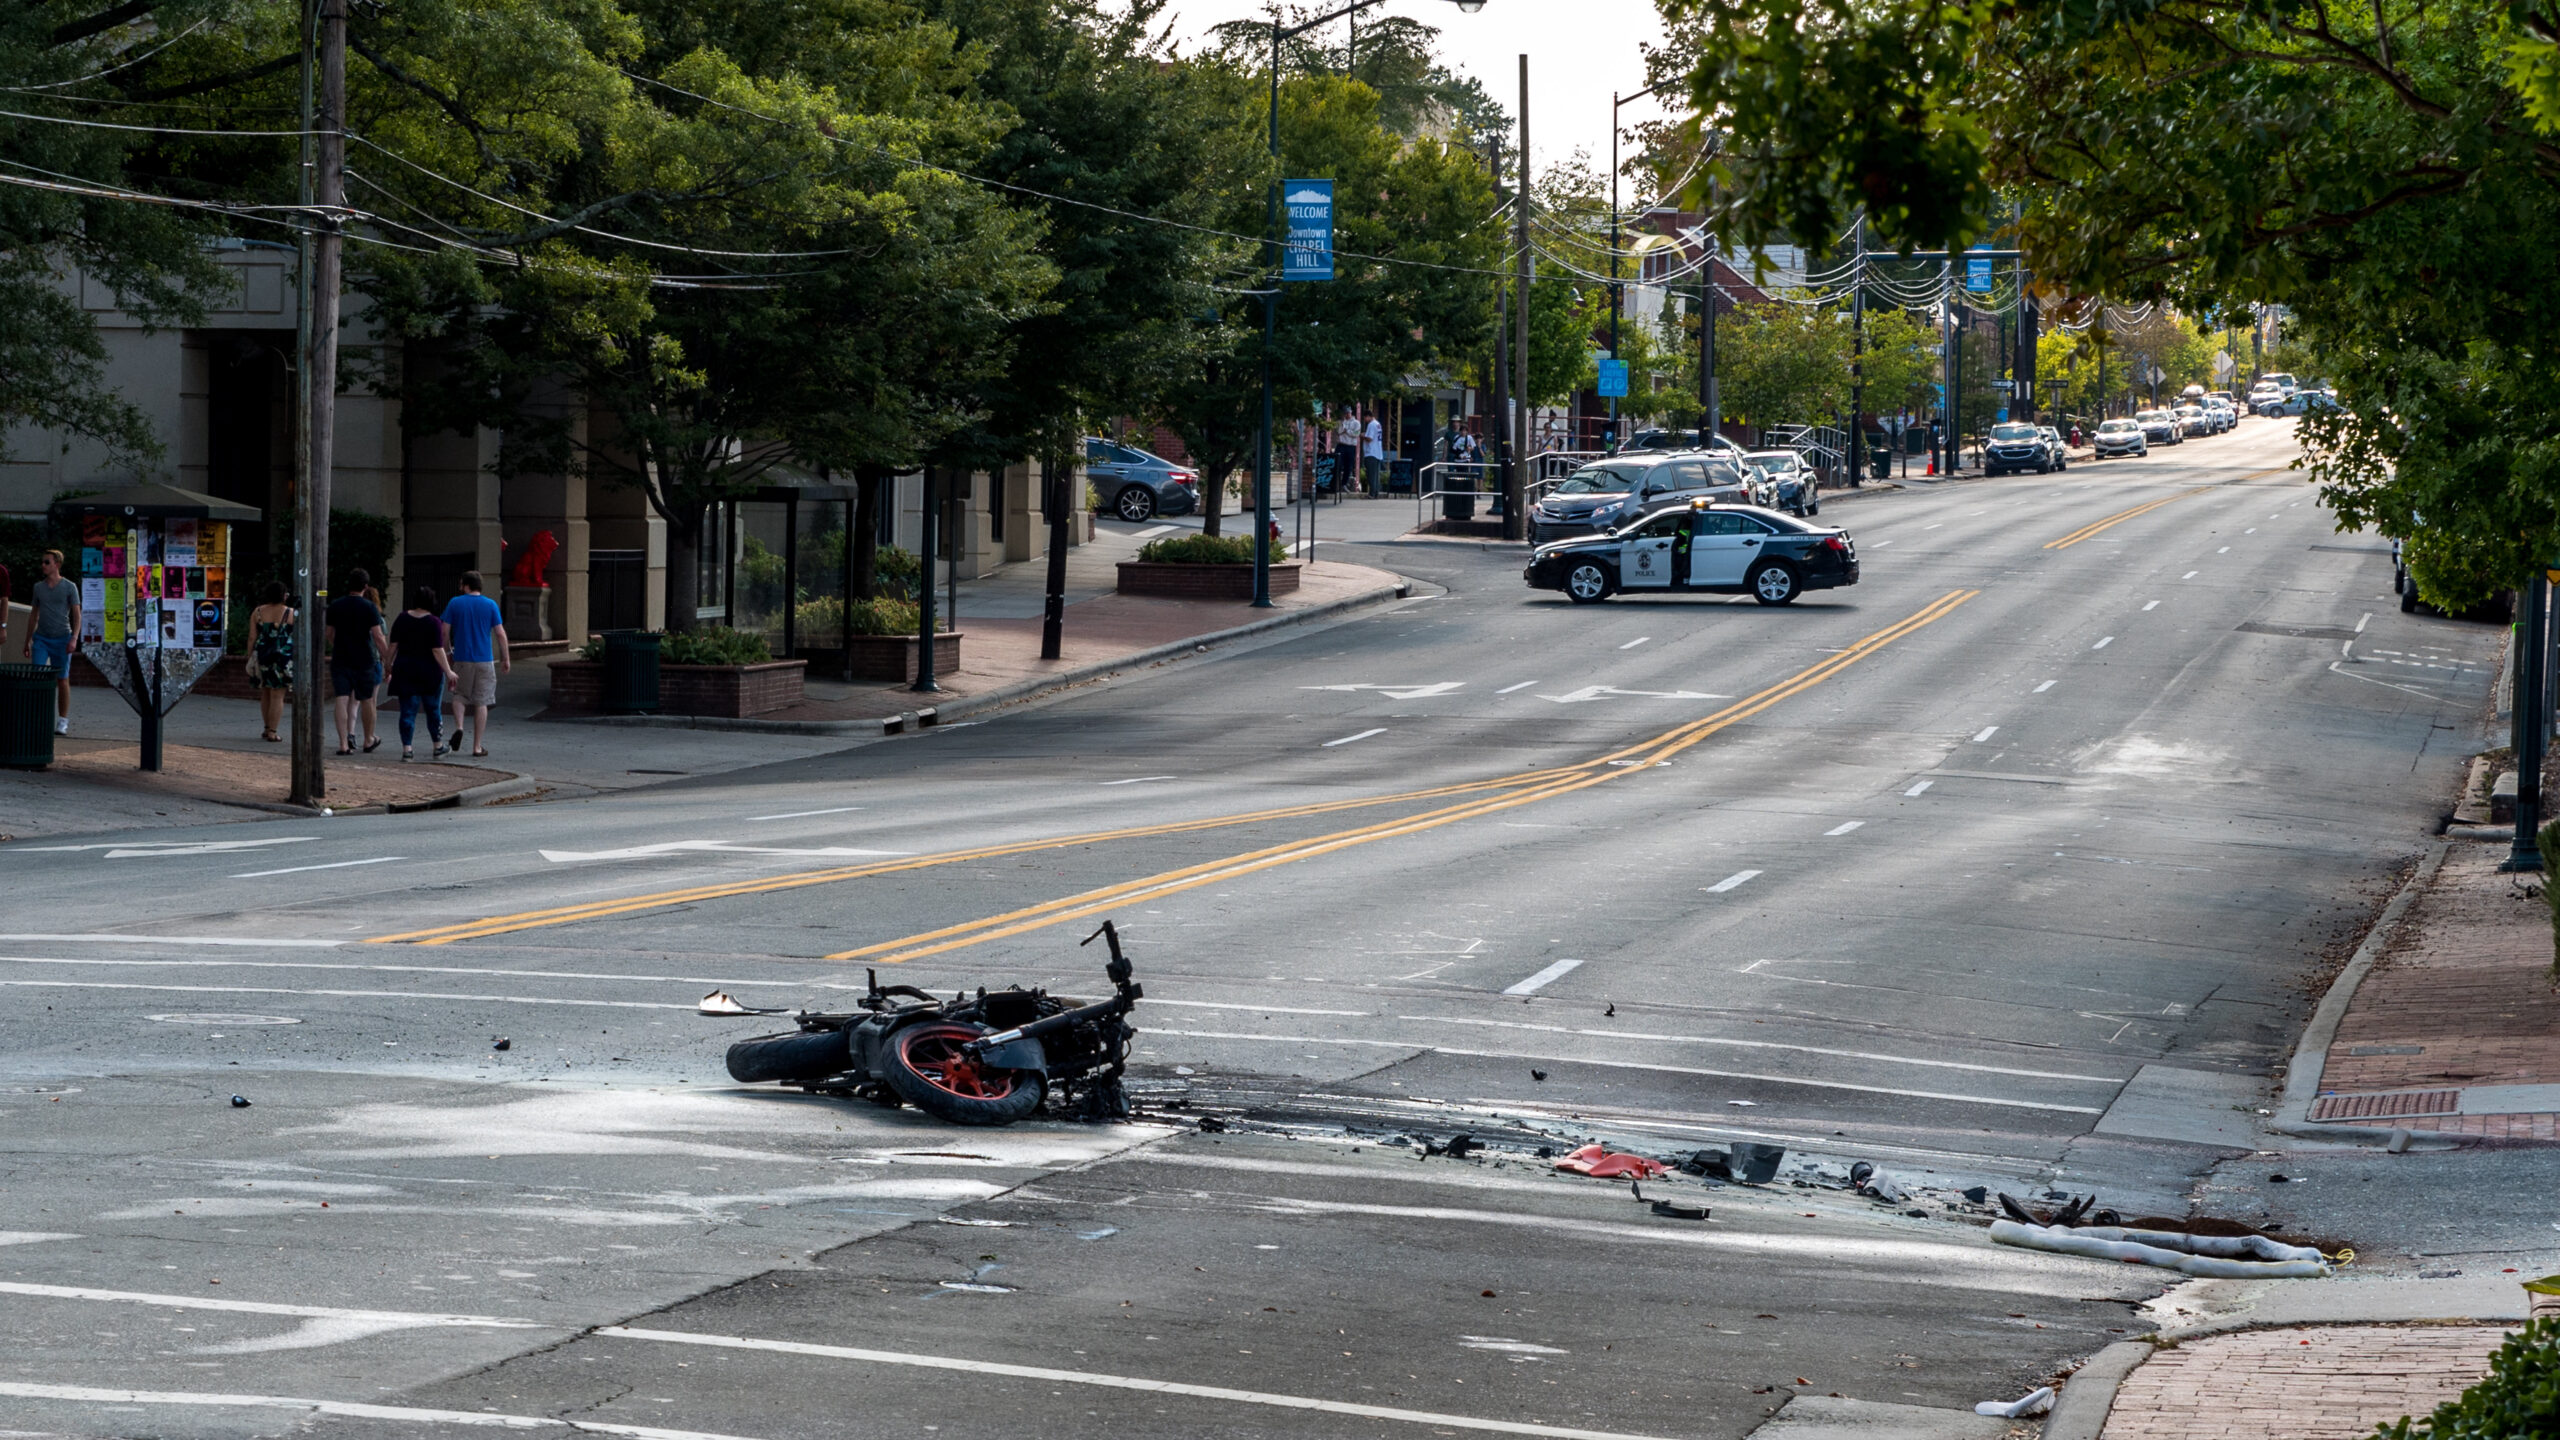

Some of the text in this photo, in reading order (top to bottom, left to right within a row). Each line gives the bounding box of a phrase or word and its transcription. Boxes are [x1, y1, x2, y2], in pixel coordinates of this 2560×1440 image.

[1288, 206, 1328, 218] WELCOME
[1288, 225, 1326, 239] Downtown
[1288, 240, 1326, 254] CHAPEL
[1296, 254, 1319, 267] HILL
